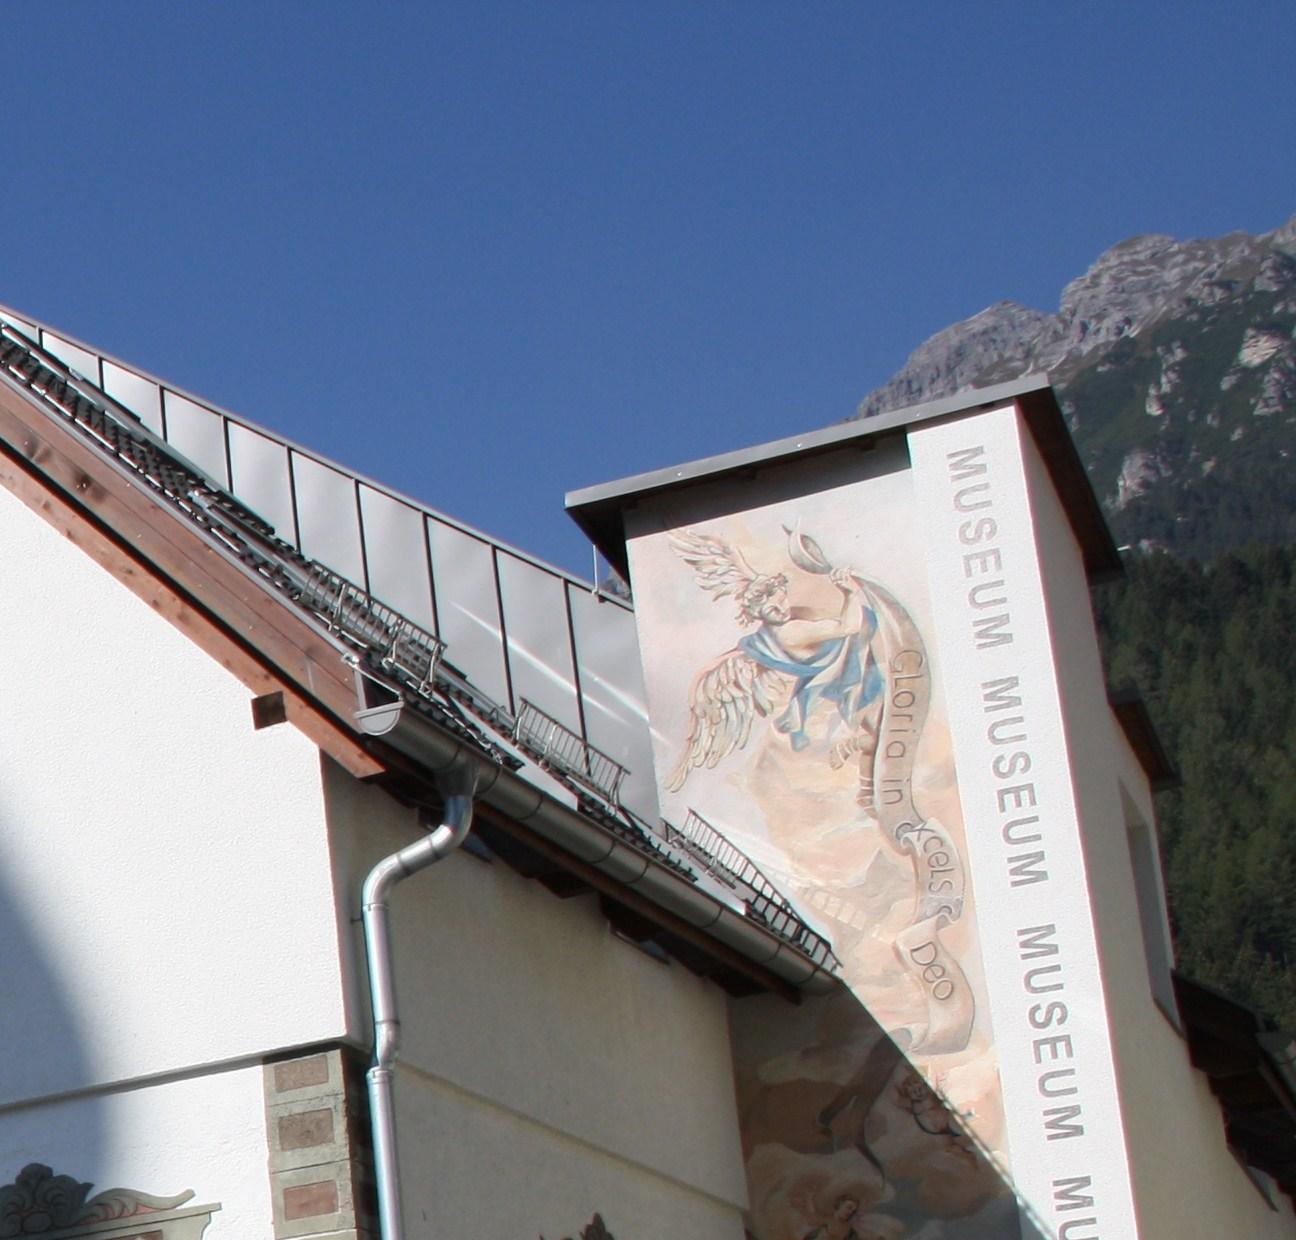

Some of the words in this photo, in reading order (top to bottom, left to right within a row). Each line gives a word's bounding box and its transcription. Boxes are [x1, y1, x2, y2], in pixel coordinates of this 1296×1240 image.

[882, 777, 910, 806] in
[946, 444, 1013, 651] MUSEUM
[981, 674, 1049, 889] MUSEUM
[1016, 921, 1084, 1144] MUSEUM
